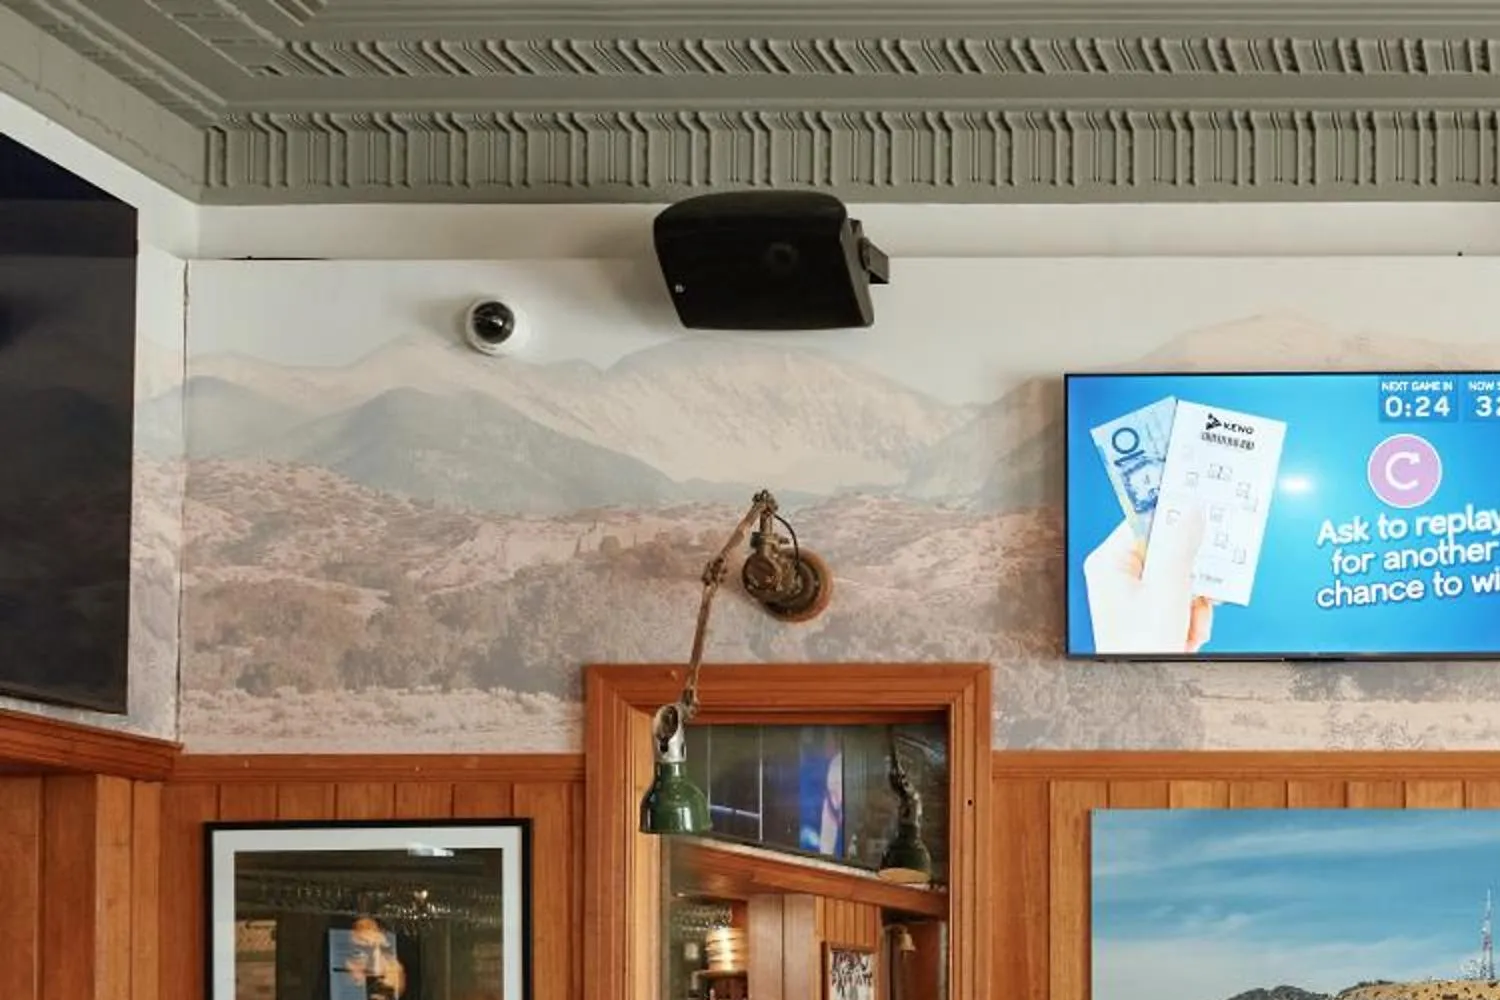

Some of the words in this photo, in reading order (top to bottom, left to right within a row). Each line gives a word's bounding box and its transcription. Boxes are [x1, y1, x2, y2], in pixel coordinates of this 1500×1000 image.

[1381, 380, 1408, 392] NEXT
[1411, 380, 1440, 391] GAME
[1443, 380, 1453, 392] IN
[1468, 380, 1494, 391] NOW
[1385, 395, 1450, 417] 0:24
[1223, 421, 1254, 436] KENO
[1316, 515, 1370, 547] Ask
[1377, 511, 1408, 540] to
[1331, 548, 1375, 575] for
[1383, 537, 1499, 571] another
[1315, 579, 1425, 608] chance
[1432, 571, 1463, 597] to
